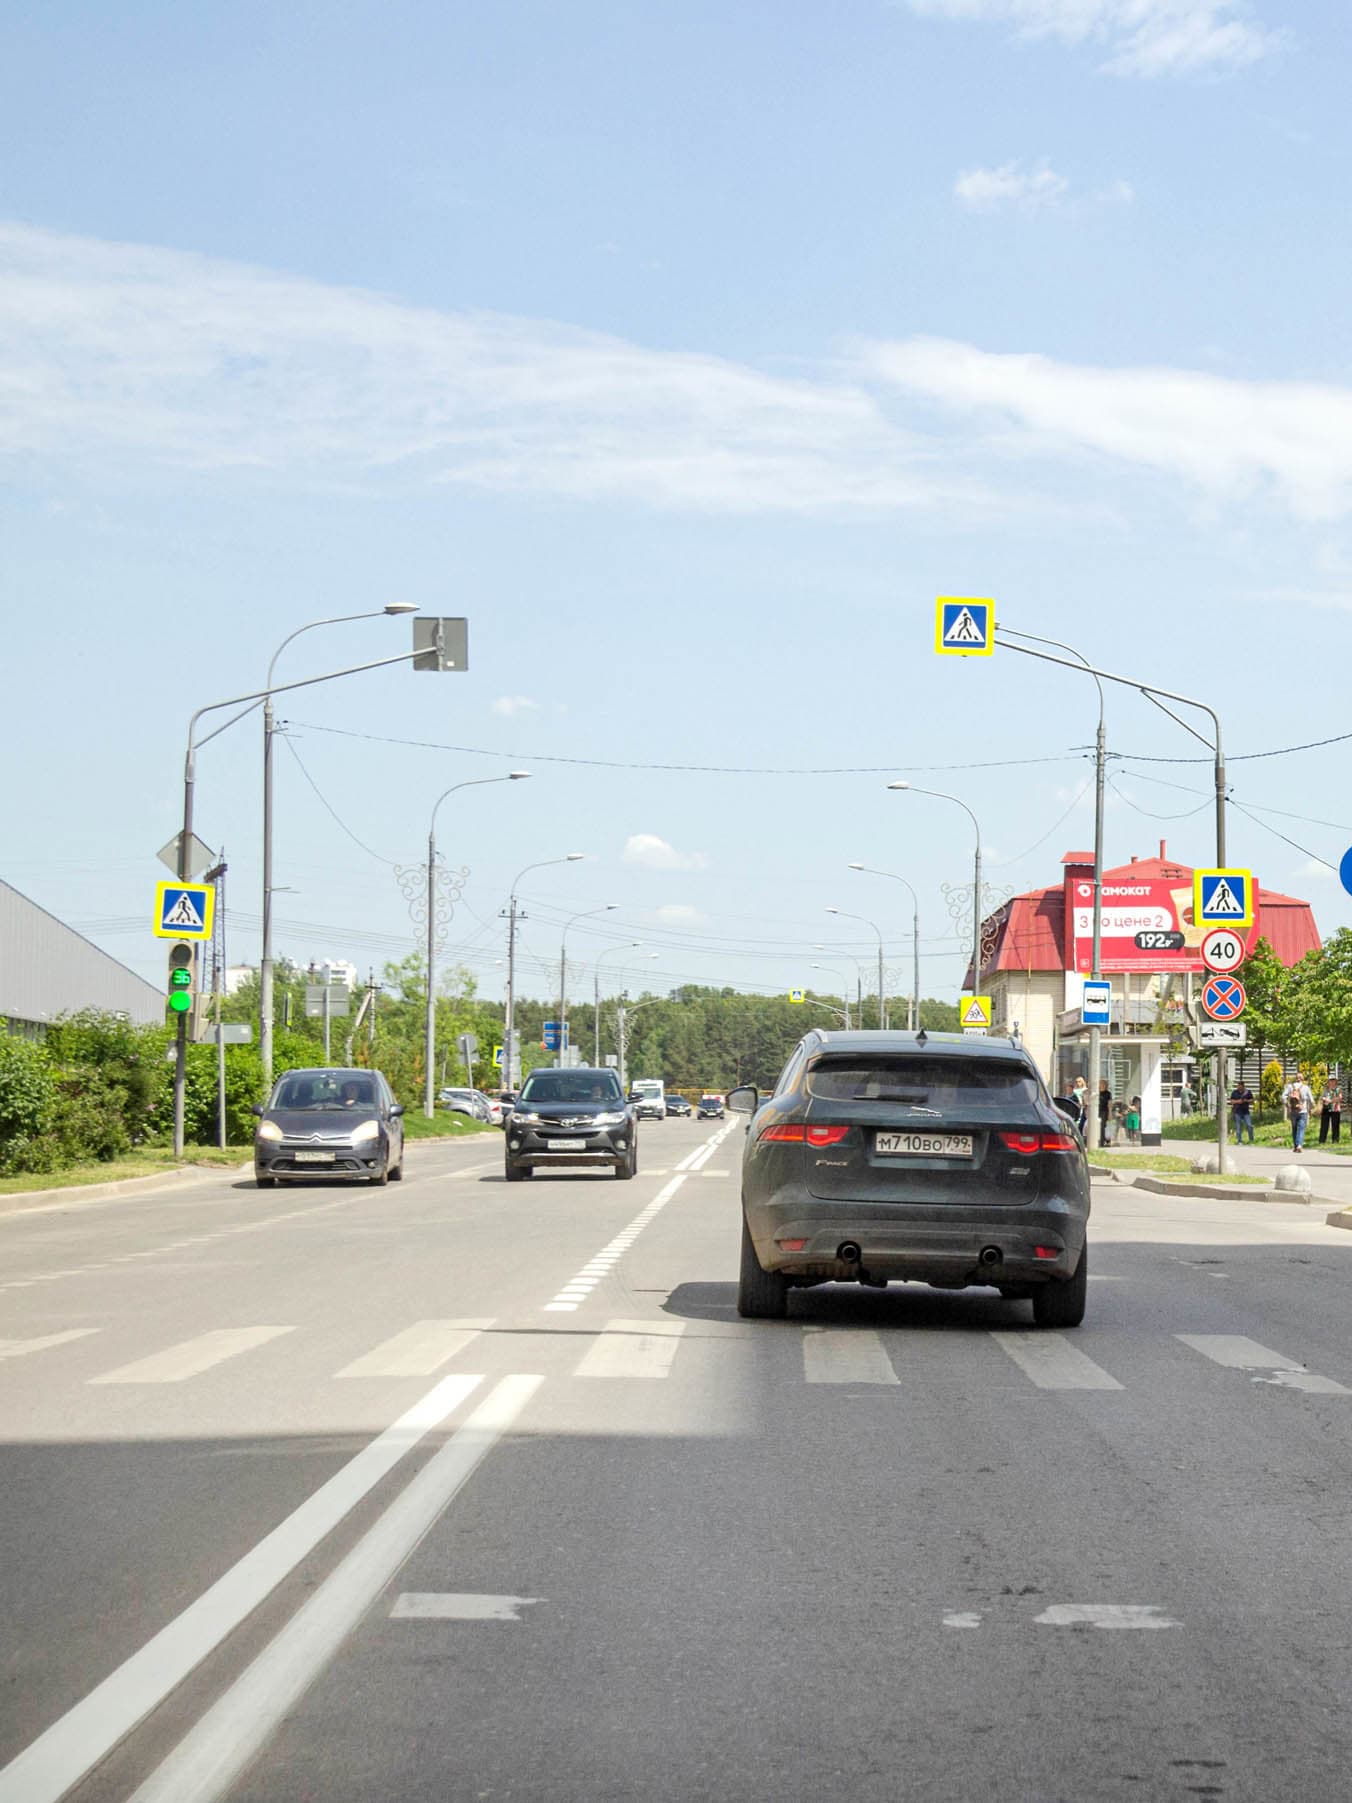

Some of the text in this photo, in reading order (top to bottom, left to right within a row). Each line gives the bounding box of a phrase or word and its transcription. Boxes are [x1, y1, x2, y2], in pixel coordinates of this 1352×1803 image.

[1095, 886, 1152, 897] амокат
[1079, 915, 1089, 928] 3
[1114, 917, 1152, 929] цене
[1155, 915, 1164, 928] 2
[1209, 942, 1235, 959] 40
[174, 970, 191, 984] 36
